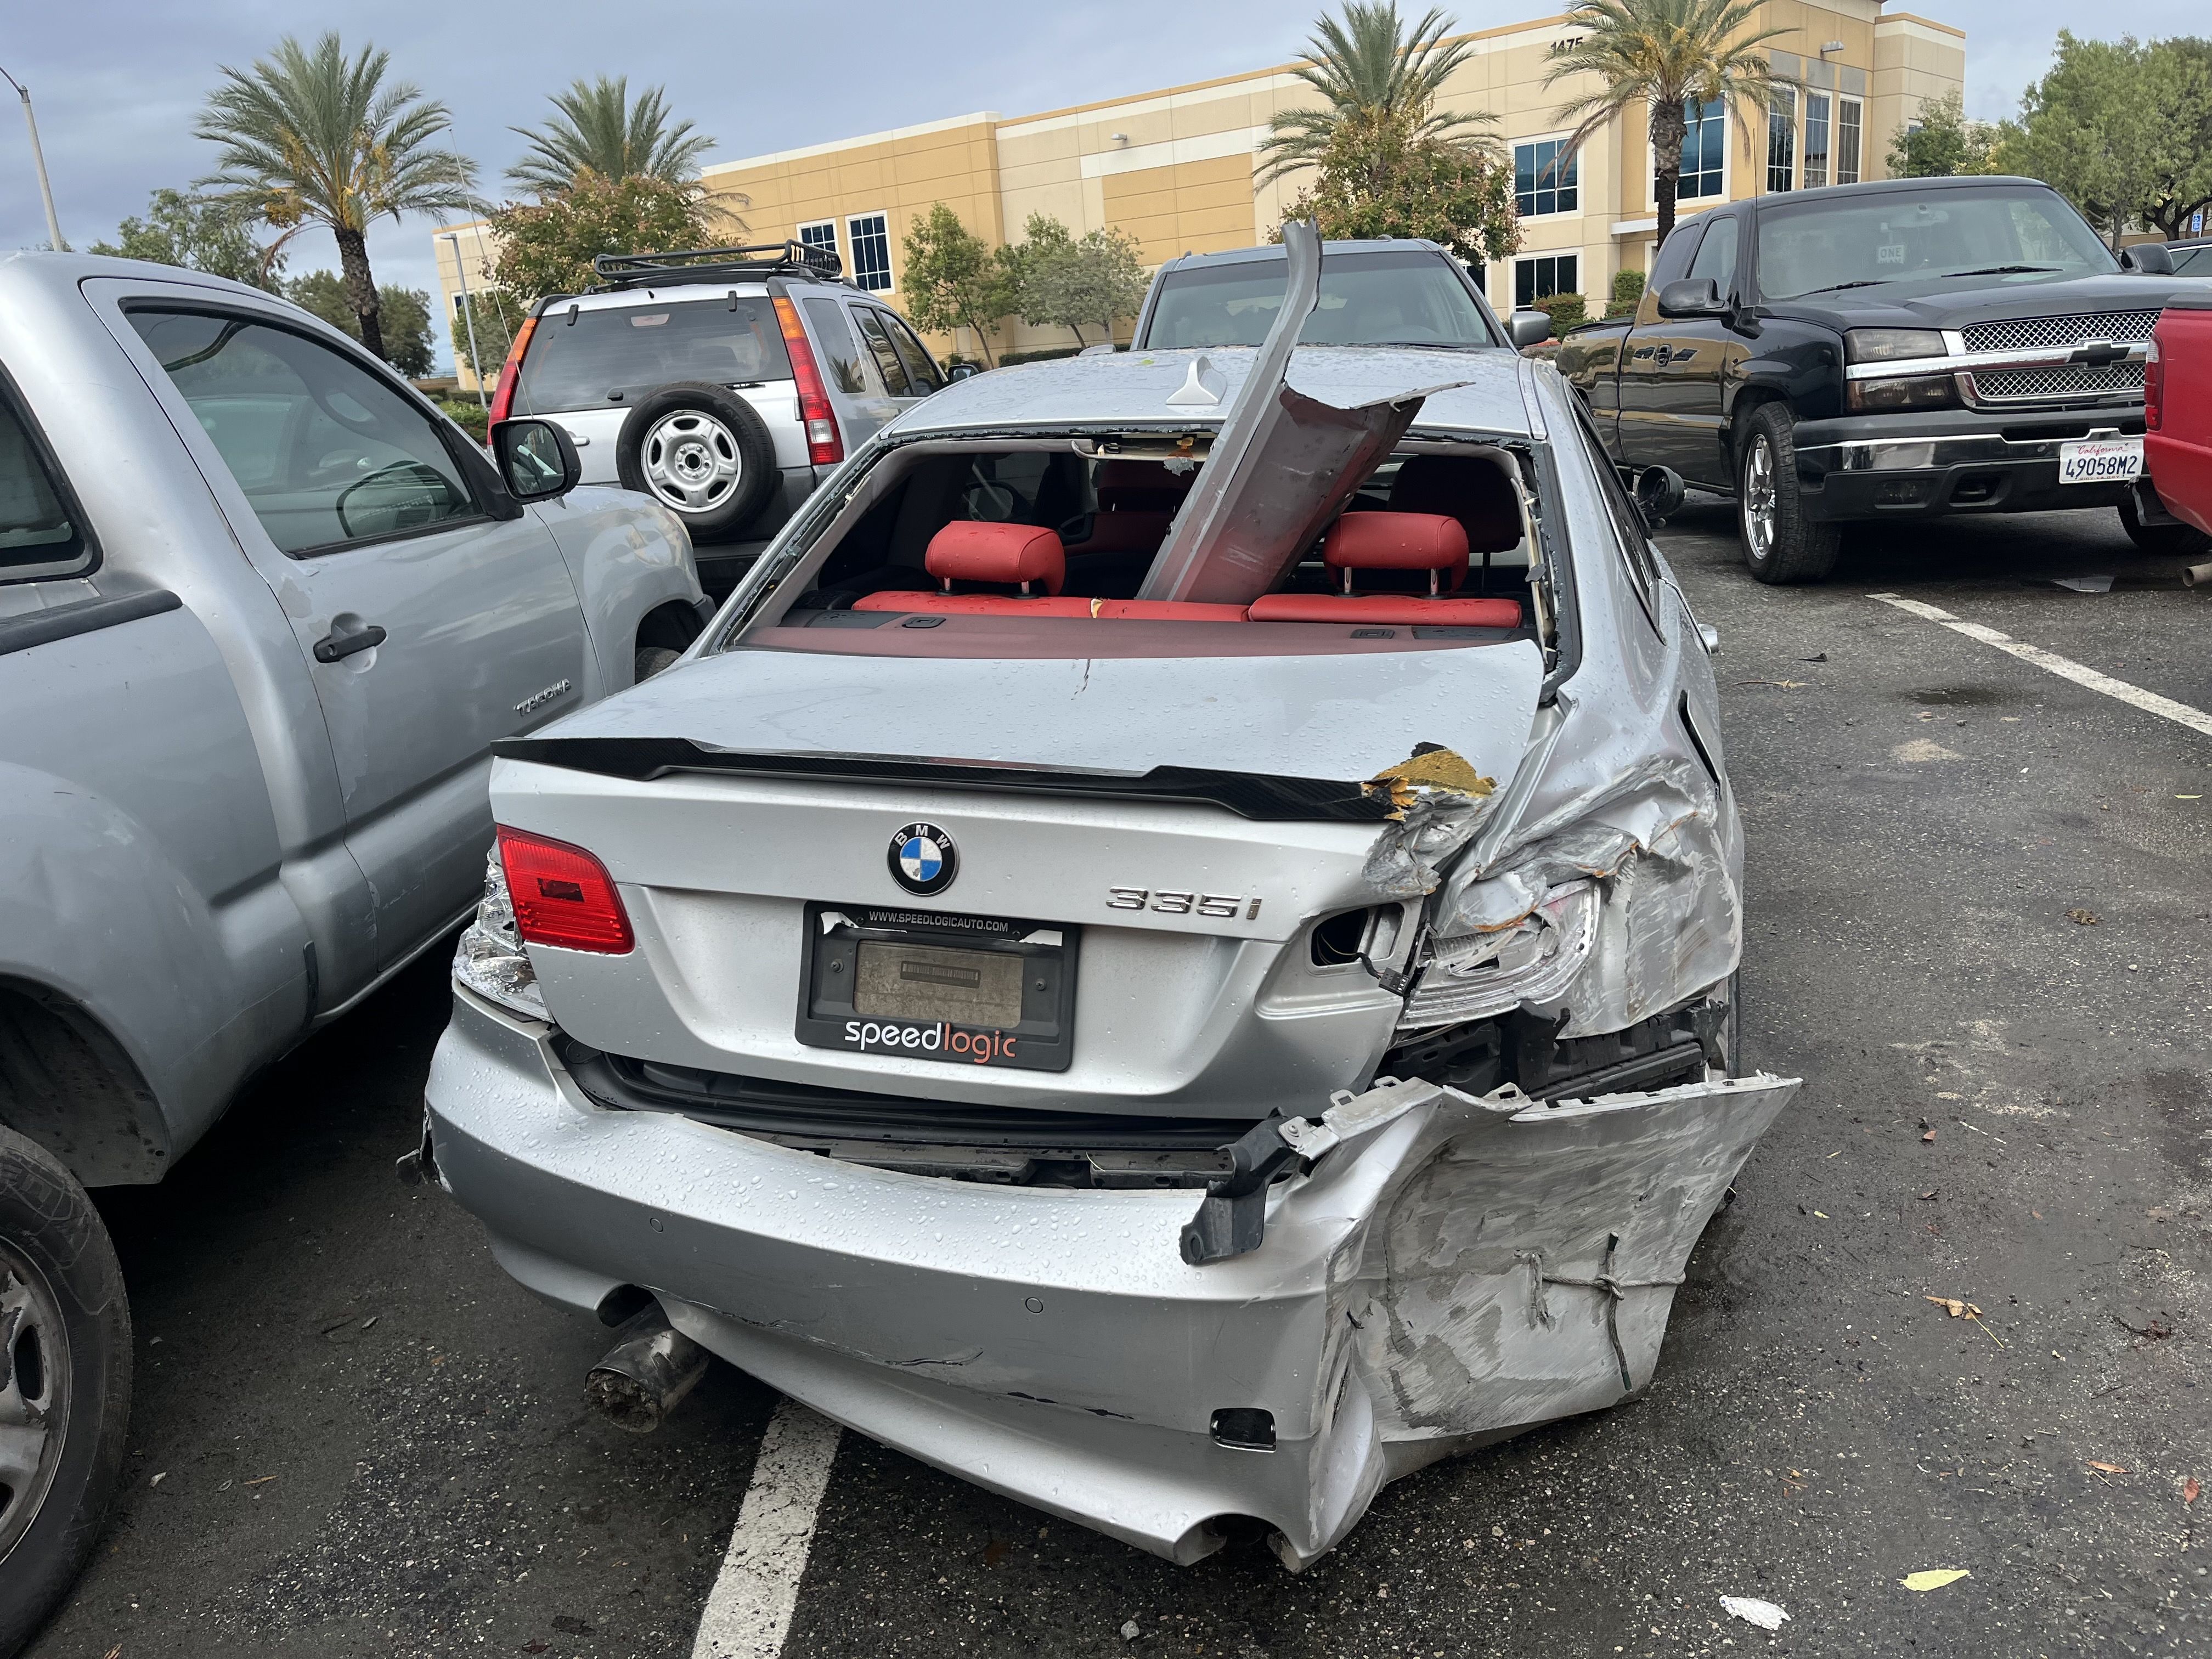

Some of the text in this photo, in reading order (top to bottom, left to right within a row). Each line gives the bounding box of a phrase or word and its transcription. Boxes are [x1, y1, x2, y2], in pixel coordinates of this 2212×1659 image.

[1881, 247, 1901, 258] ONE
[2078, 444, 2126, 456] California
[2066, 455, 2138, 477] 49058M2
[514, 679, 571, 715] TACOMA
[894, 825, 950, 849] BMW
[1105, 885, 1262, 920] 335i
[869, 911, 1008, 933] WWW.SPEEDLOGICAUTO.COM
